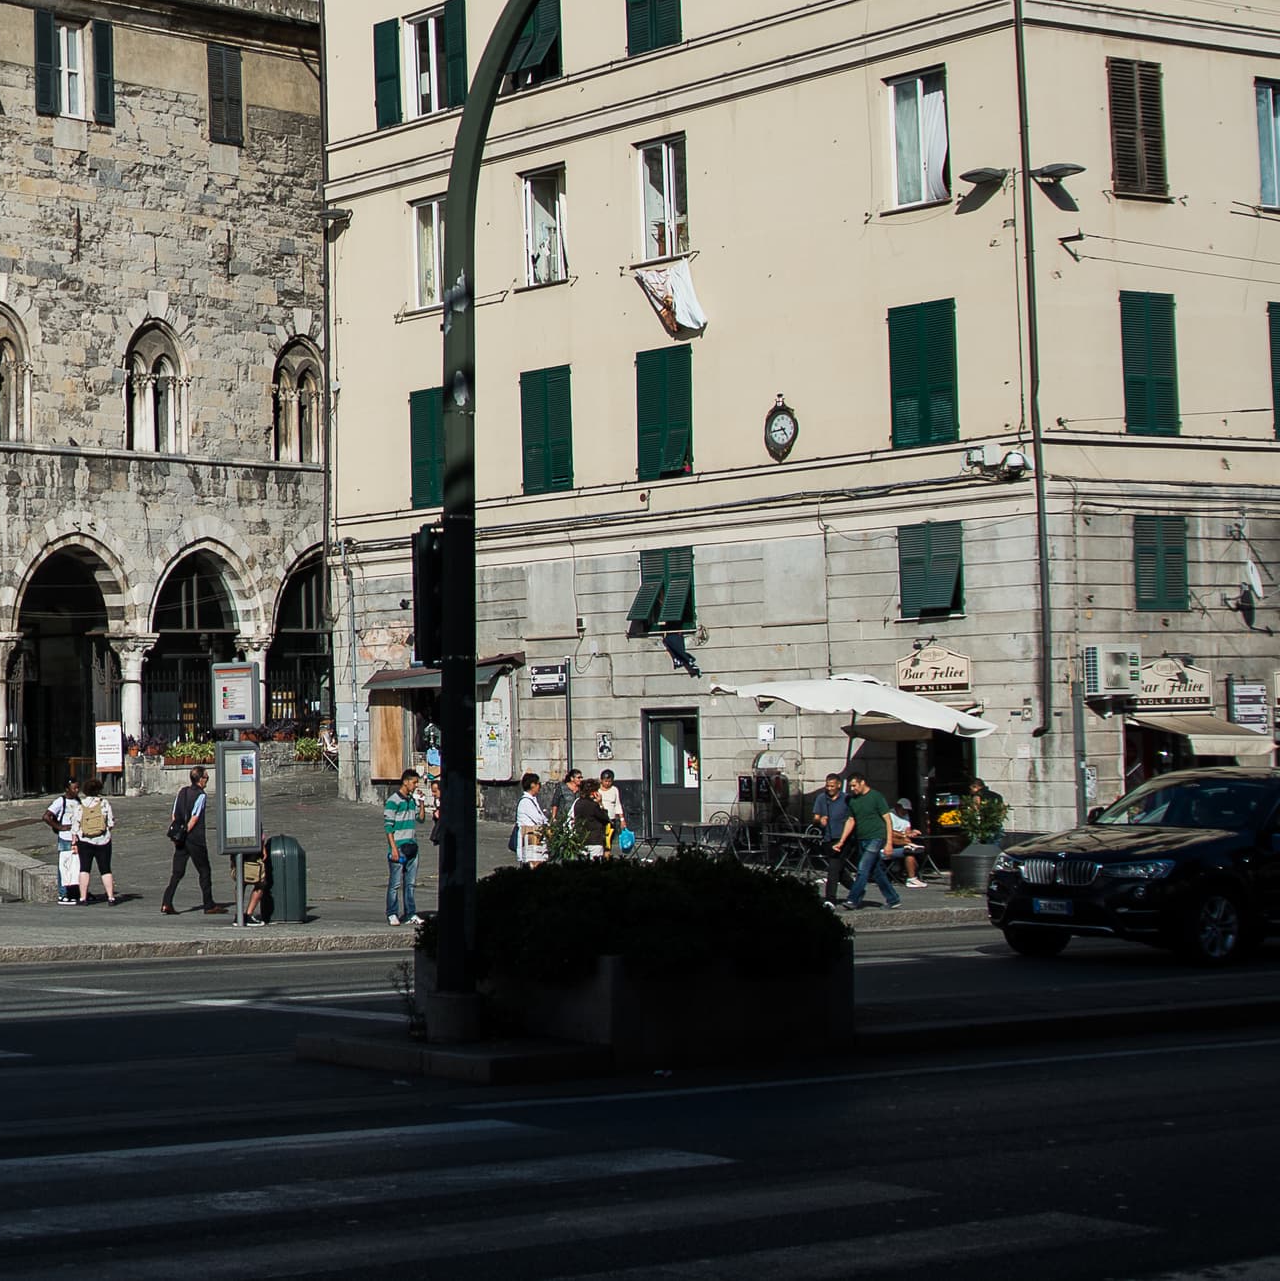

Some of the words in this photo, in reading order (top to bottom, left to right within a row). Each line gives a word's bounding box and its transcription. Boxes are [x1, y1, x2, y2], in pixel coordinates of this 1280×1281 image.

[901, 667, 925, 680] Bar
[927, 665, 965, 681] Felice
[1165, 678, 1204, 695] Felice
